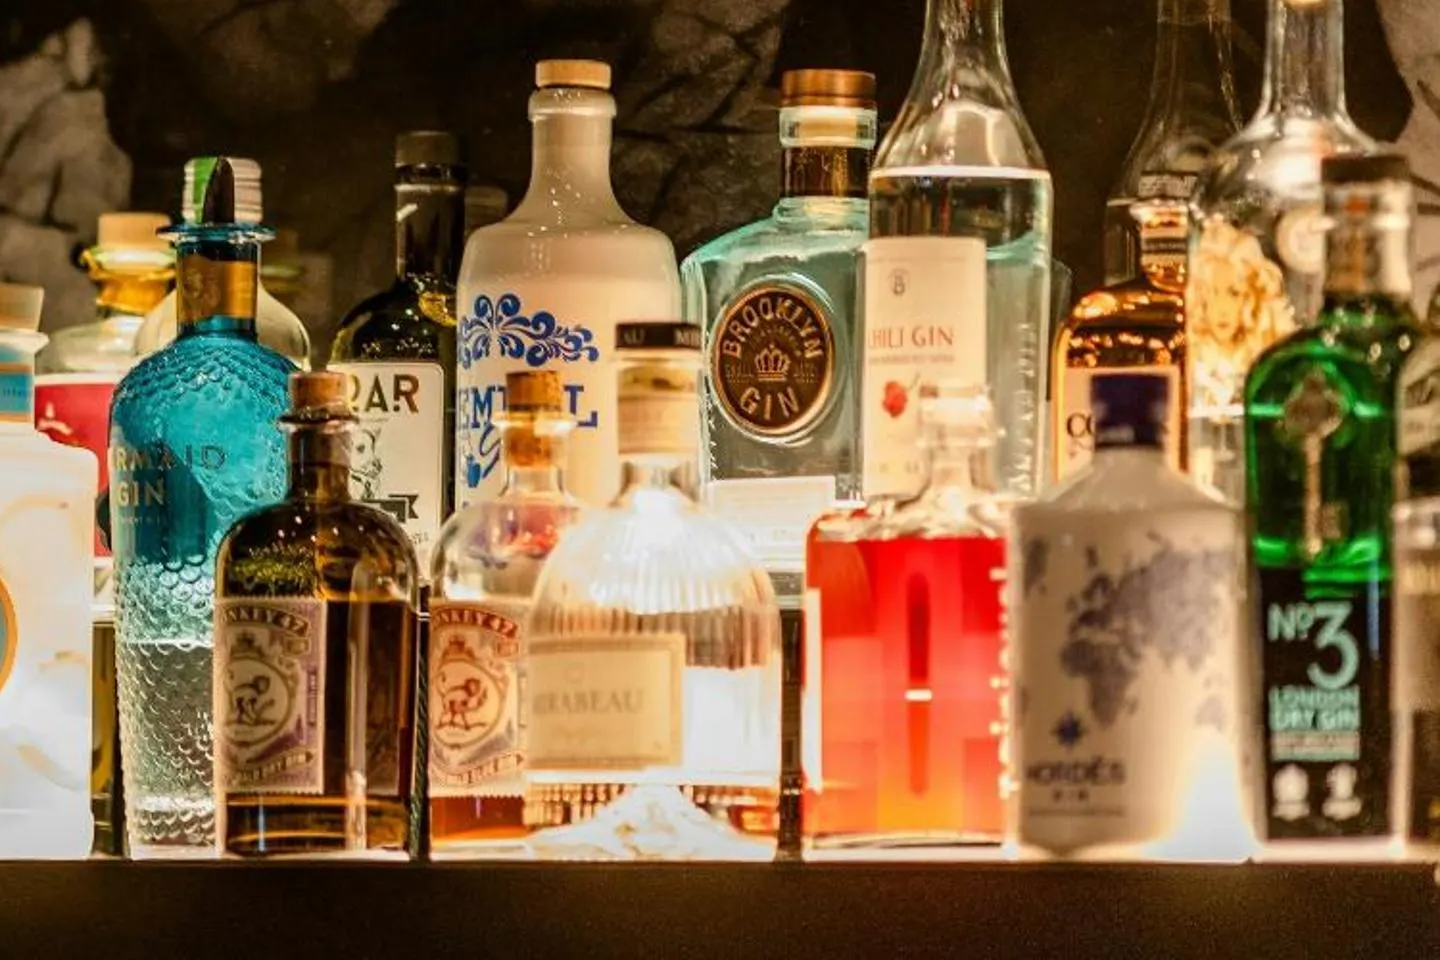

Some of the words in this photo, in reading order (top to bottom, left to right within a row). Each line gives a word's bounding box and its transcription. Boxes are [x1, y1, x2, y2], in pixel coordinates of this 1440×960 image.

[721, 296, 824, 359] BROOKLYN
[911, 325, 954, 348] GIN
[739, 387, 800, 421] GIN
[117, 480, 165, 508] GIN
